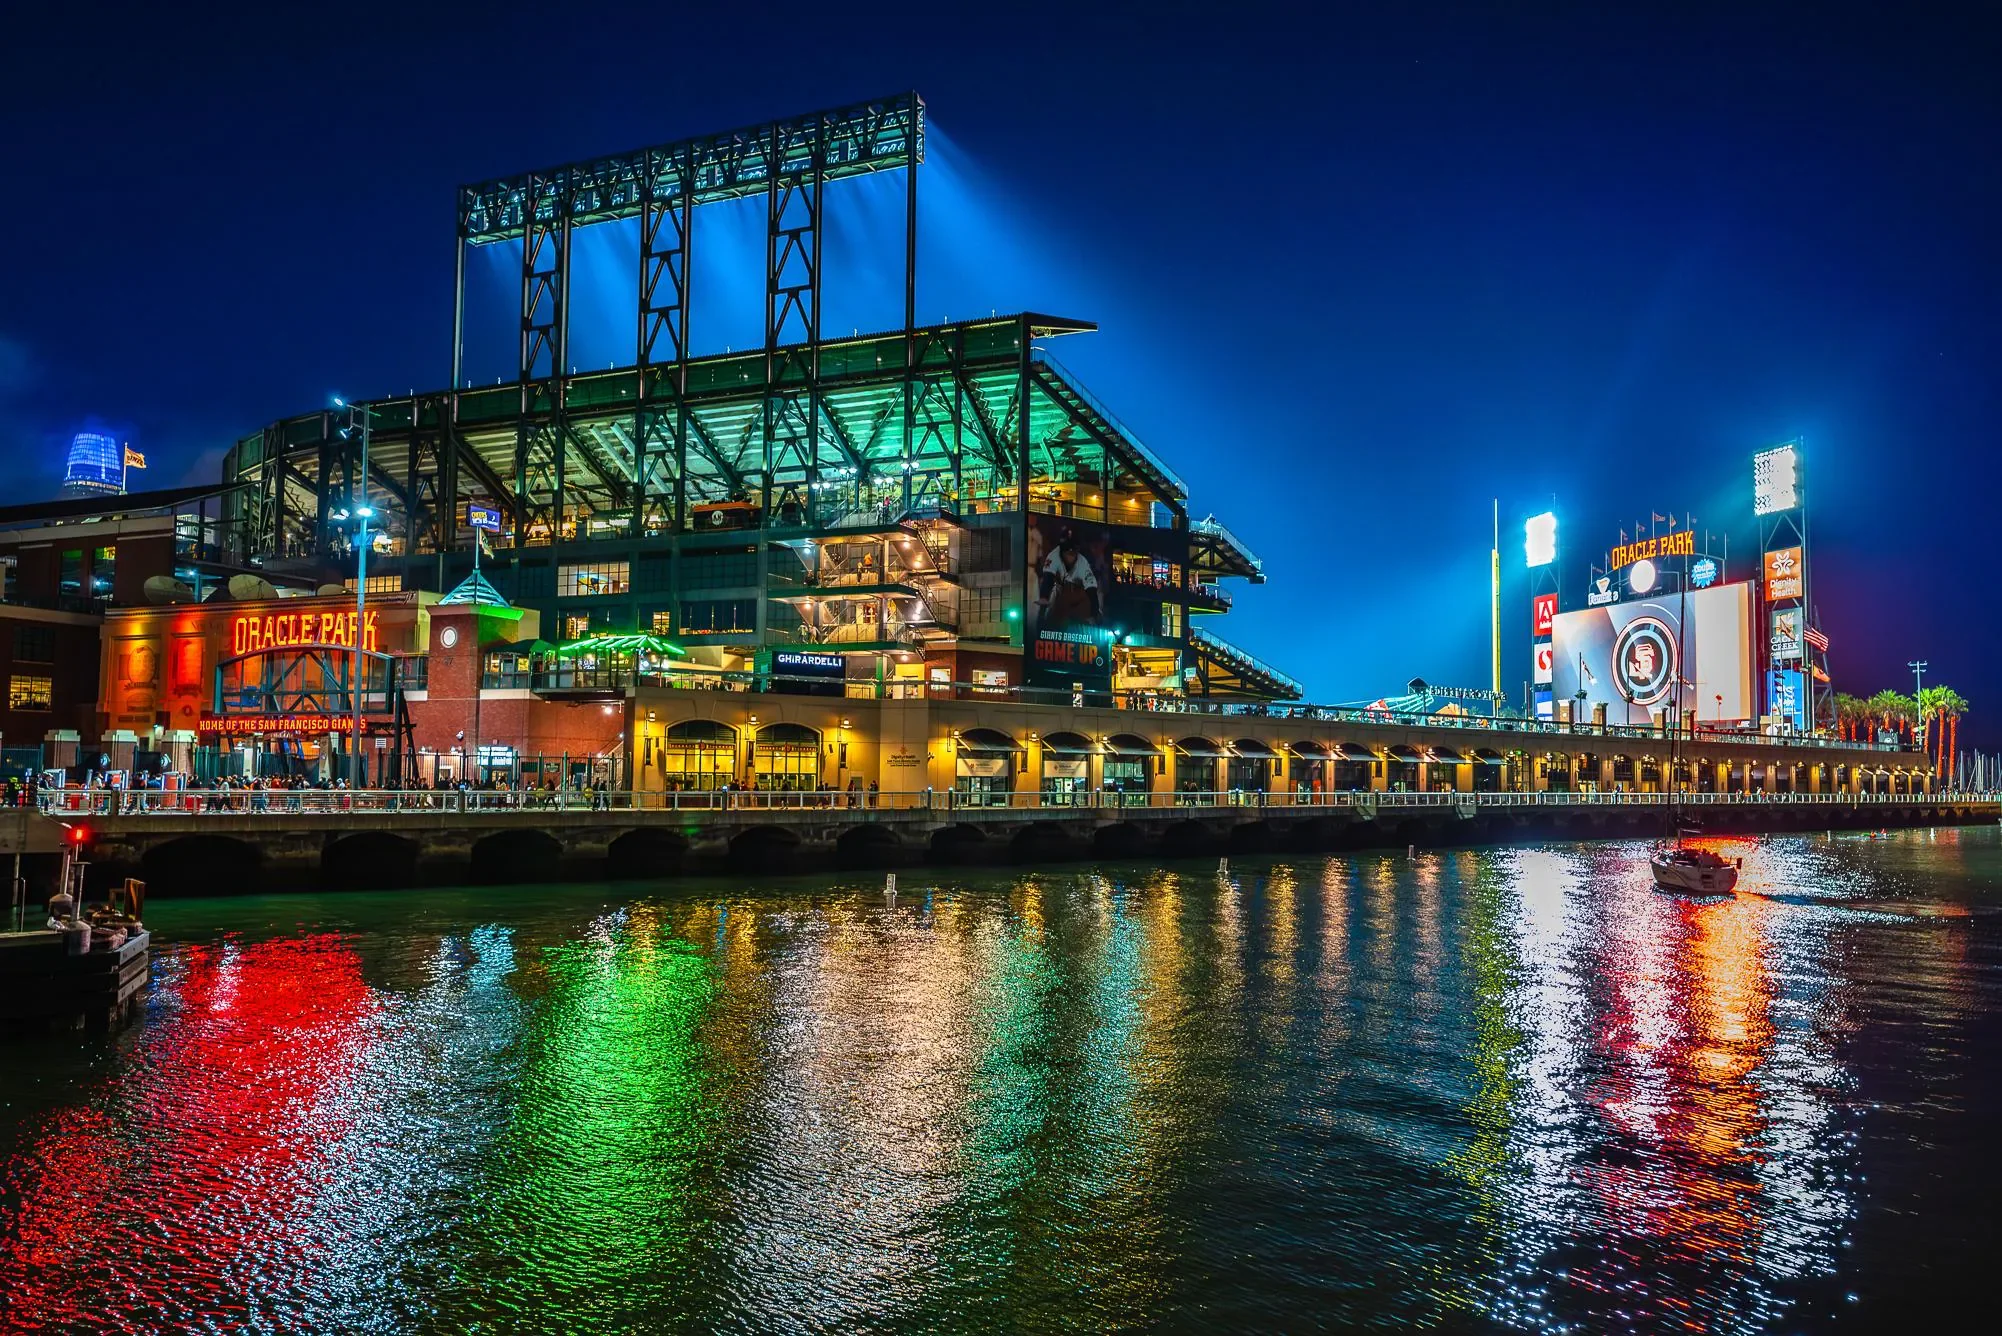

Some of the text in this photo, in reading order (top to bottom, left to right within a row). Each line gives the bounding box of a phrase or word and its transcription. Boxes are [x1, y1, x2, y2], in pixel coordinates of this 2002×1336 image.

[1612, 530, 1694, 571] ORACLE PARK
[1770, 577, 1797, 589] Dignity
[235, 614, 313, 655] ORACLE
[1040, 630, 1092, 643] GIANTS BASEBALL
[1036, 641, 1097, 664] GAME UP
[1771, 642, 1799, 651] CREEK
[778, 655, 842, 666] GHIRARDELLI
[200, 719, 366, 730] HOME OF THE SAN FRANCISCO GIANS
